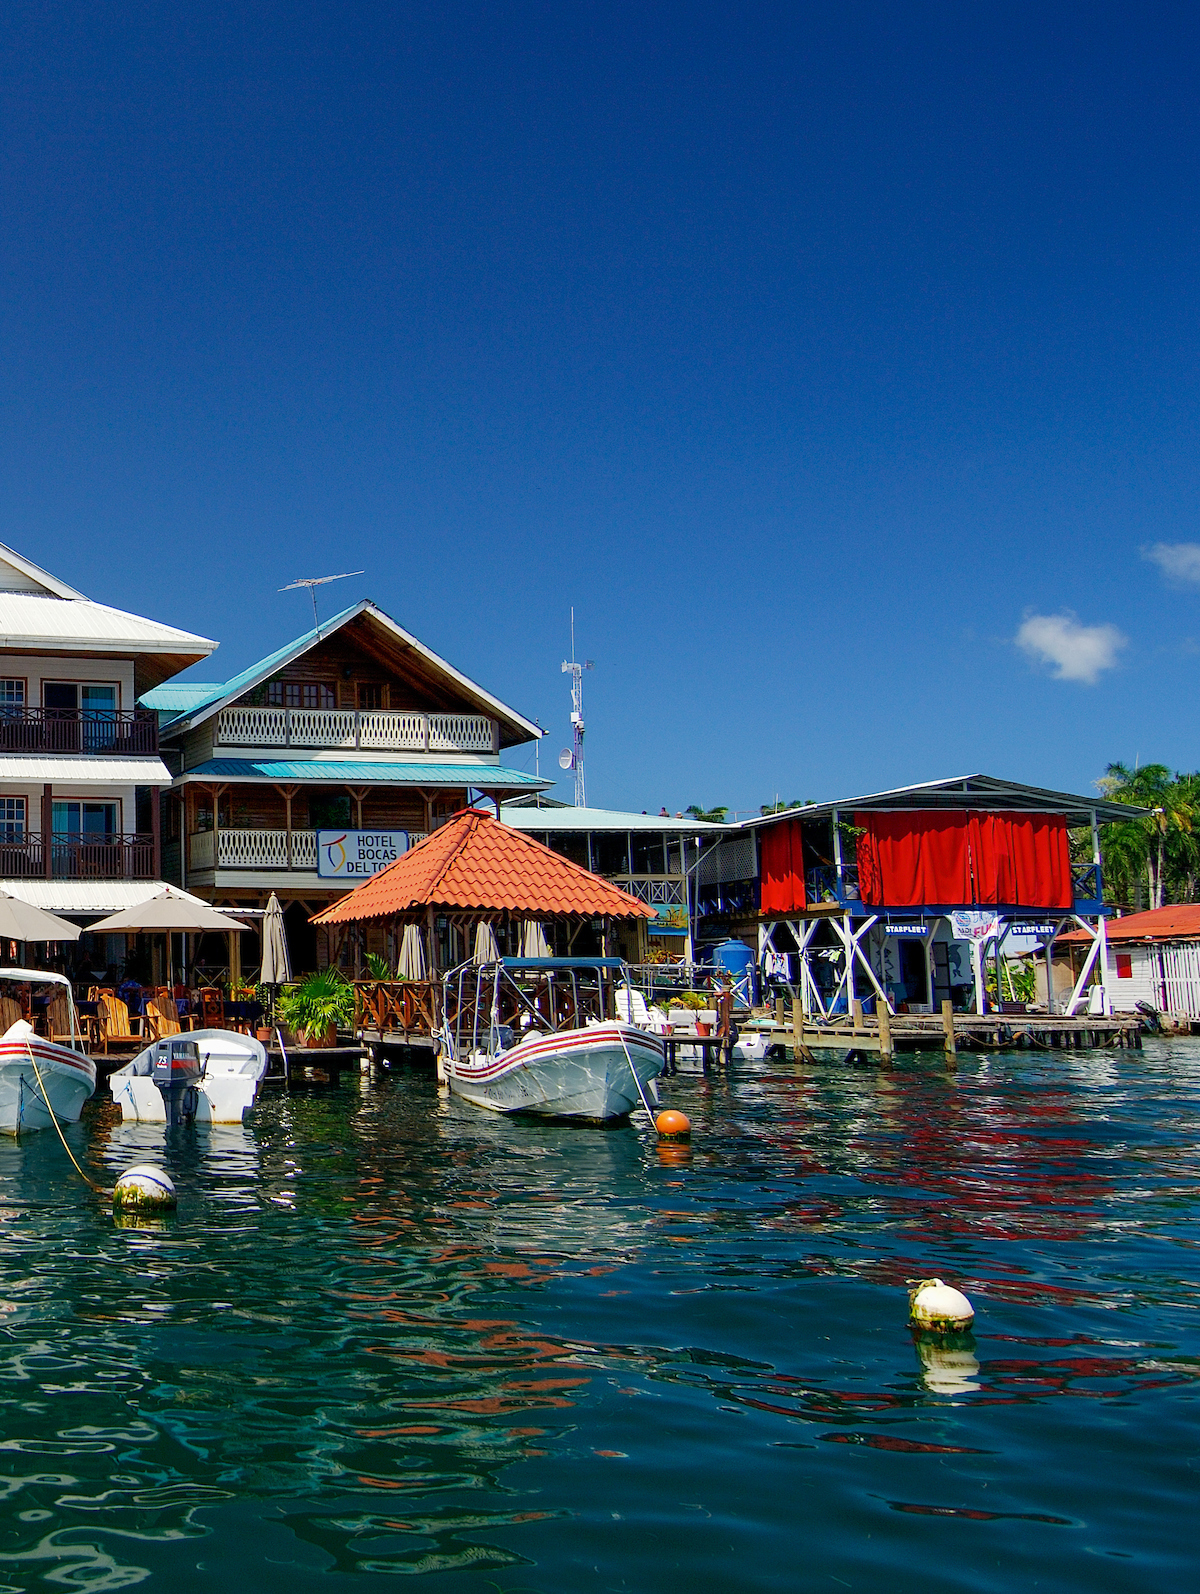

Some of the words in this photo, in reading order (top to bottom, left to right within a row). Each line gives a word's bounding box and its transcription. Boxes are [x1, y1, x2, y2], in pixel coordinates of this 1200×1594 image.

[357, 835, 396, 847] HOTEL
[358, 849, 397, 860] BOCAS
[346, 861, 371, 873] DEL
[371, 862, 392, 873] TO
[158, 1055, 168, 1064] 75
